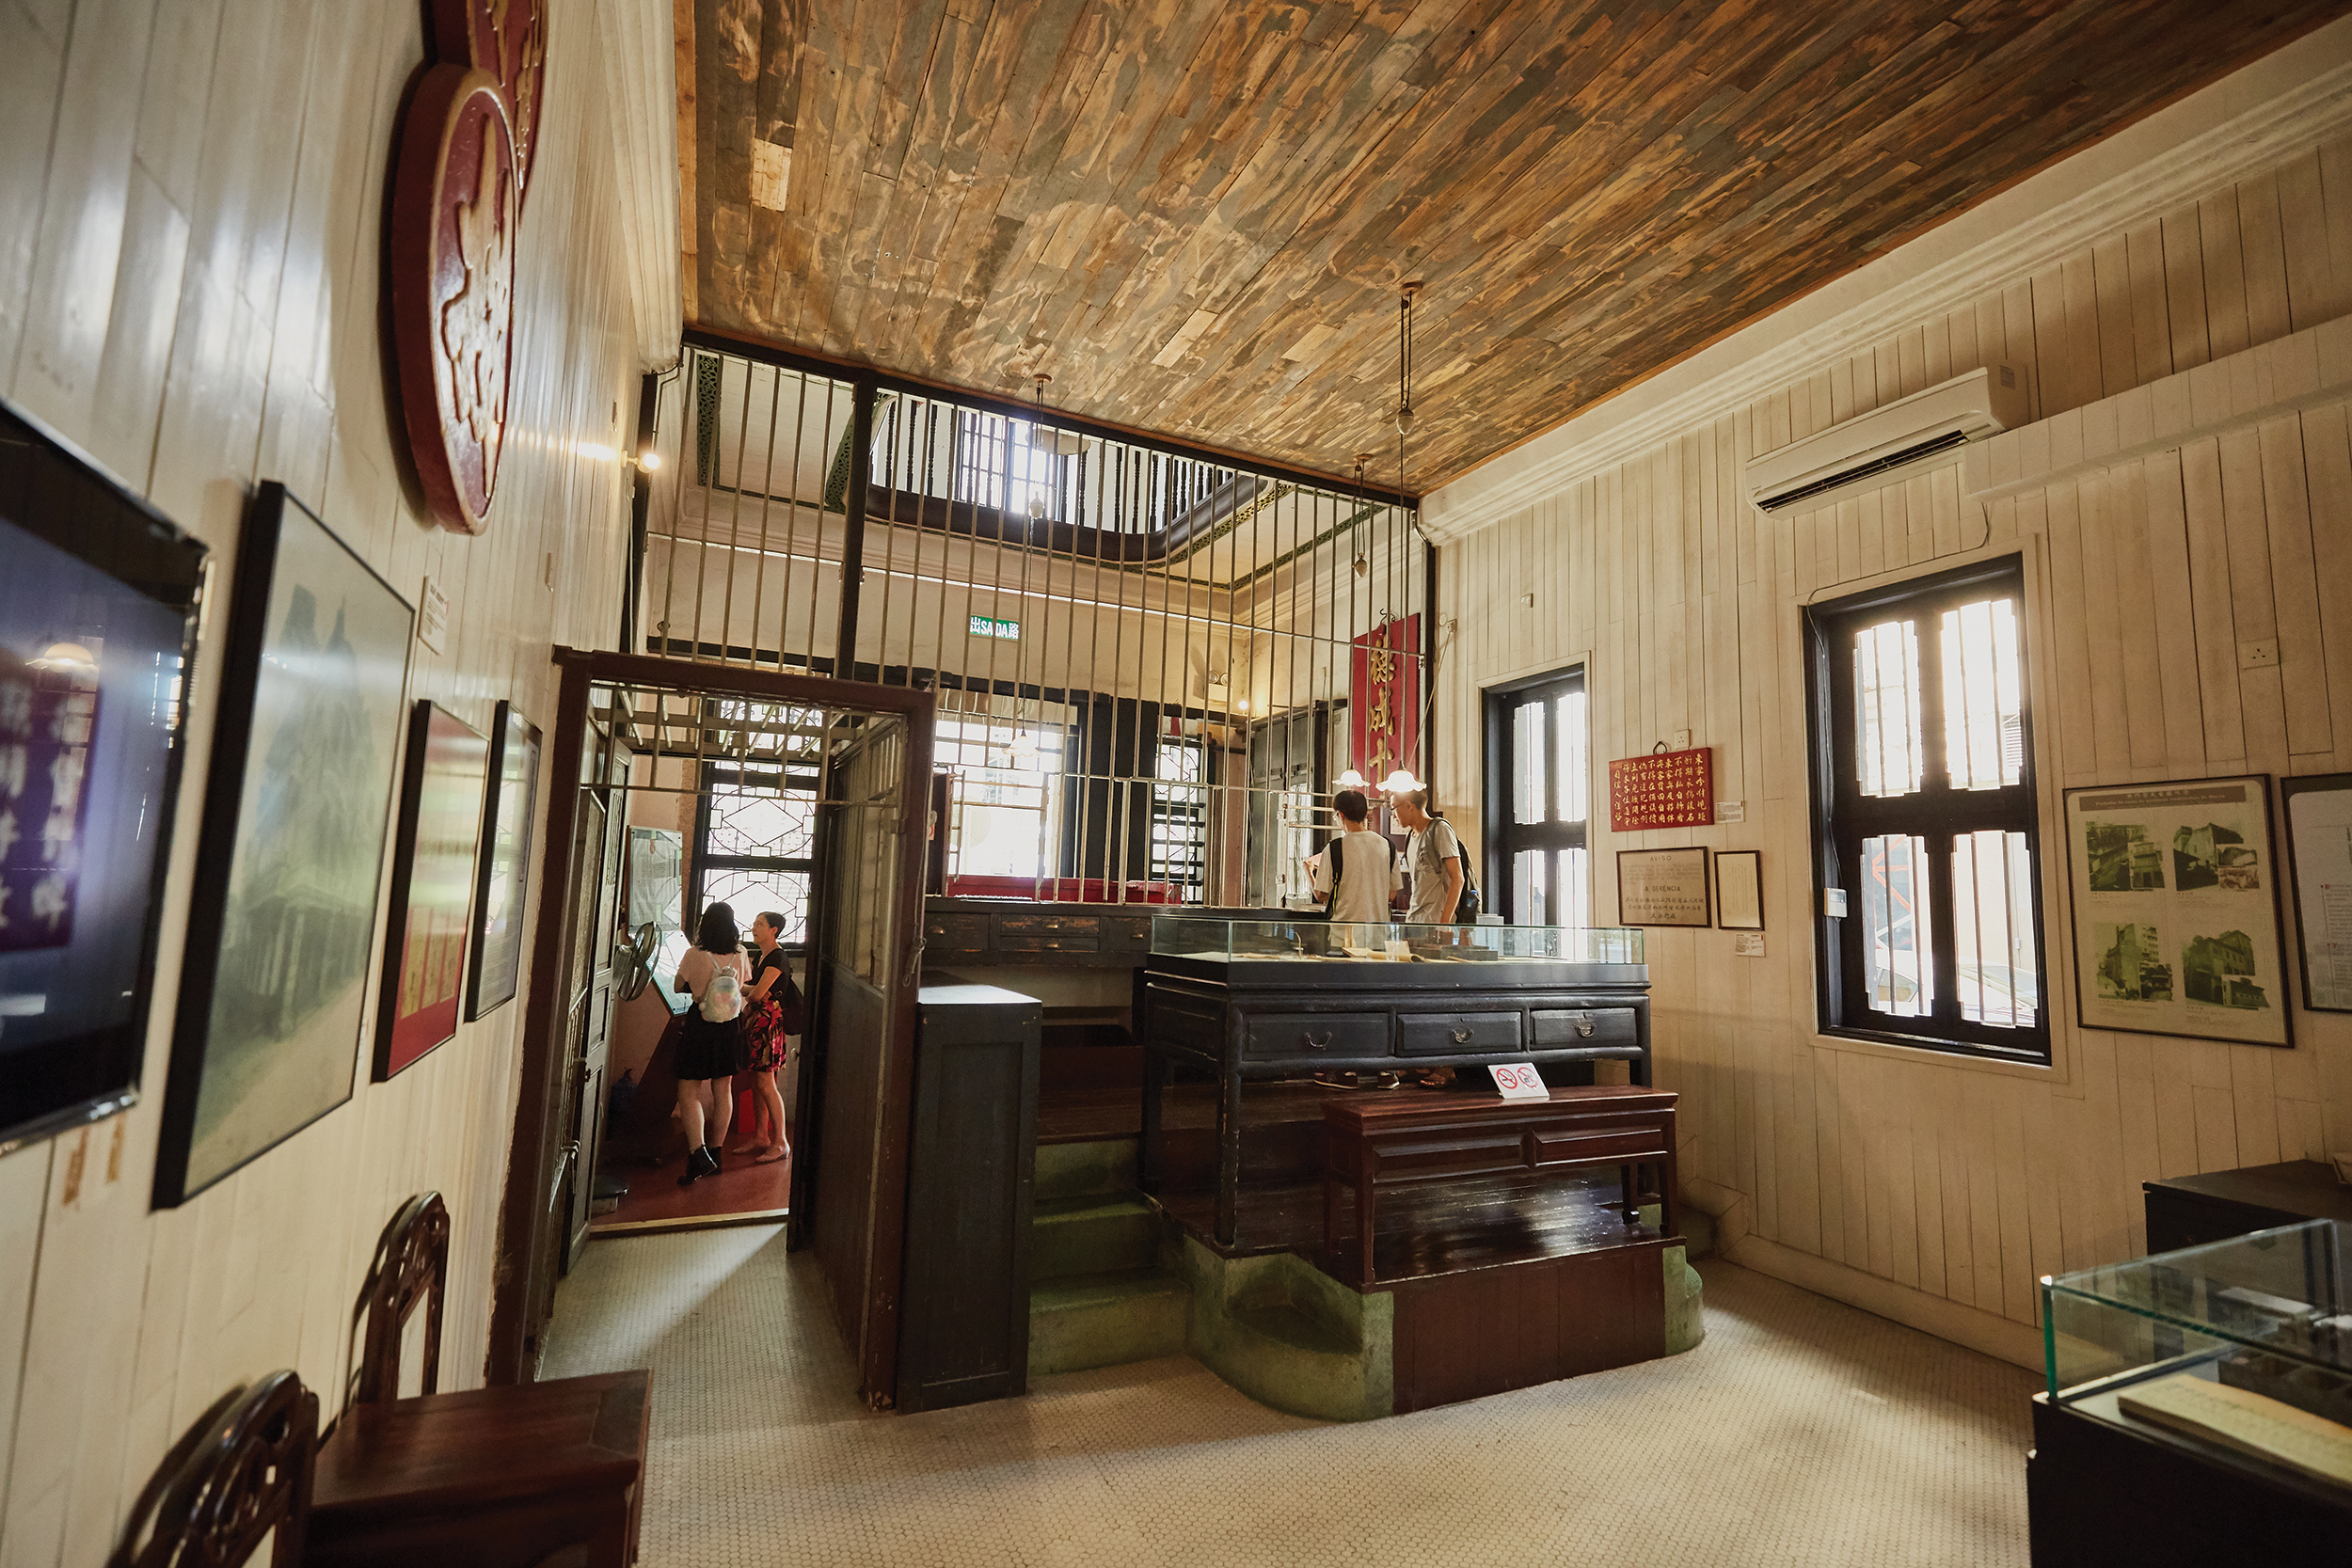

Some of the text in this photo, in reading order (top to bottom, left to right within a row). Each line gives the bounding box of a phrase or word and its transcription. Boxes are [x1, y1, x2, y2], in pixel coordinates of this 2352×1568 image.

[970, 616, 1020, 640] 出 SADA 路
